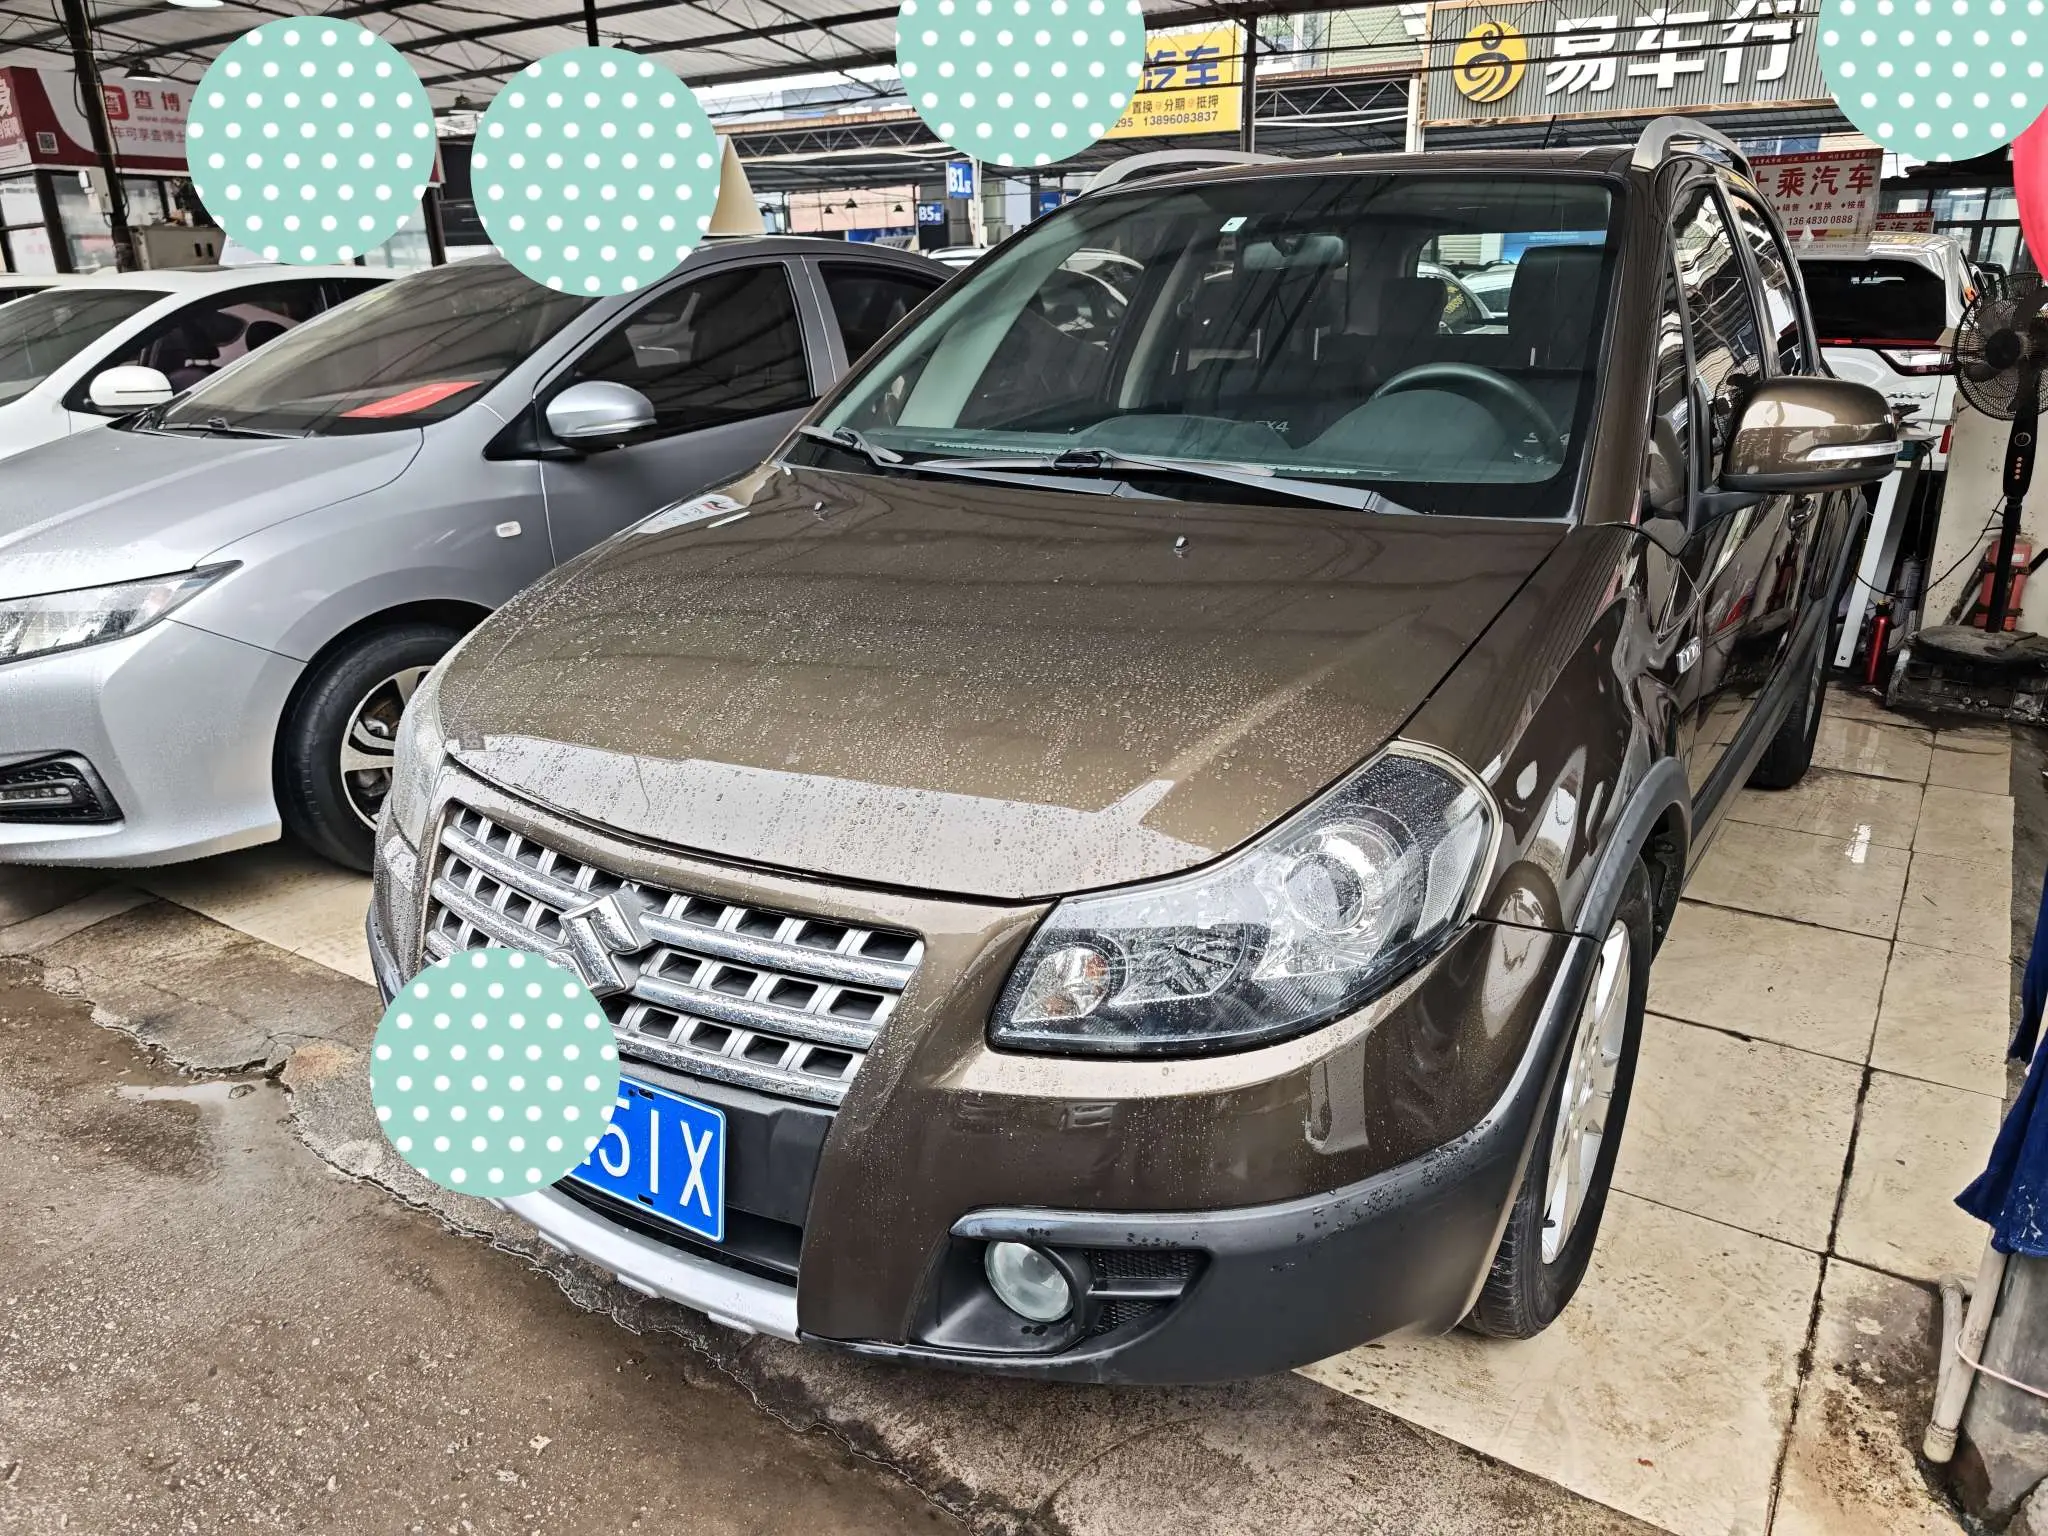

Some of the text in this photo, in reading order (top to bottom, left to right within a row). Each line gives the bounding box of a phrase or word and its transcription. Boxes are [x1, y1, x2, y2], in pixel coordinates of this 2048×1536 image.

[1145, 45, 1220, 91] 汽车
[1545, 0, 1804, 96] 易车行
[132, 90, 192, 112] 查博
[1143, 111, 1219, 126] 13896083837
[583, 1098, 713, 1217] 51X
